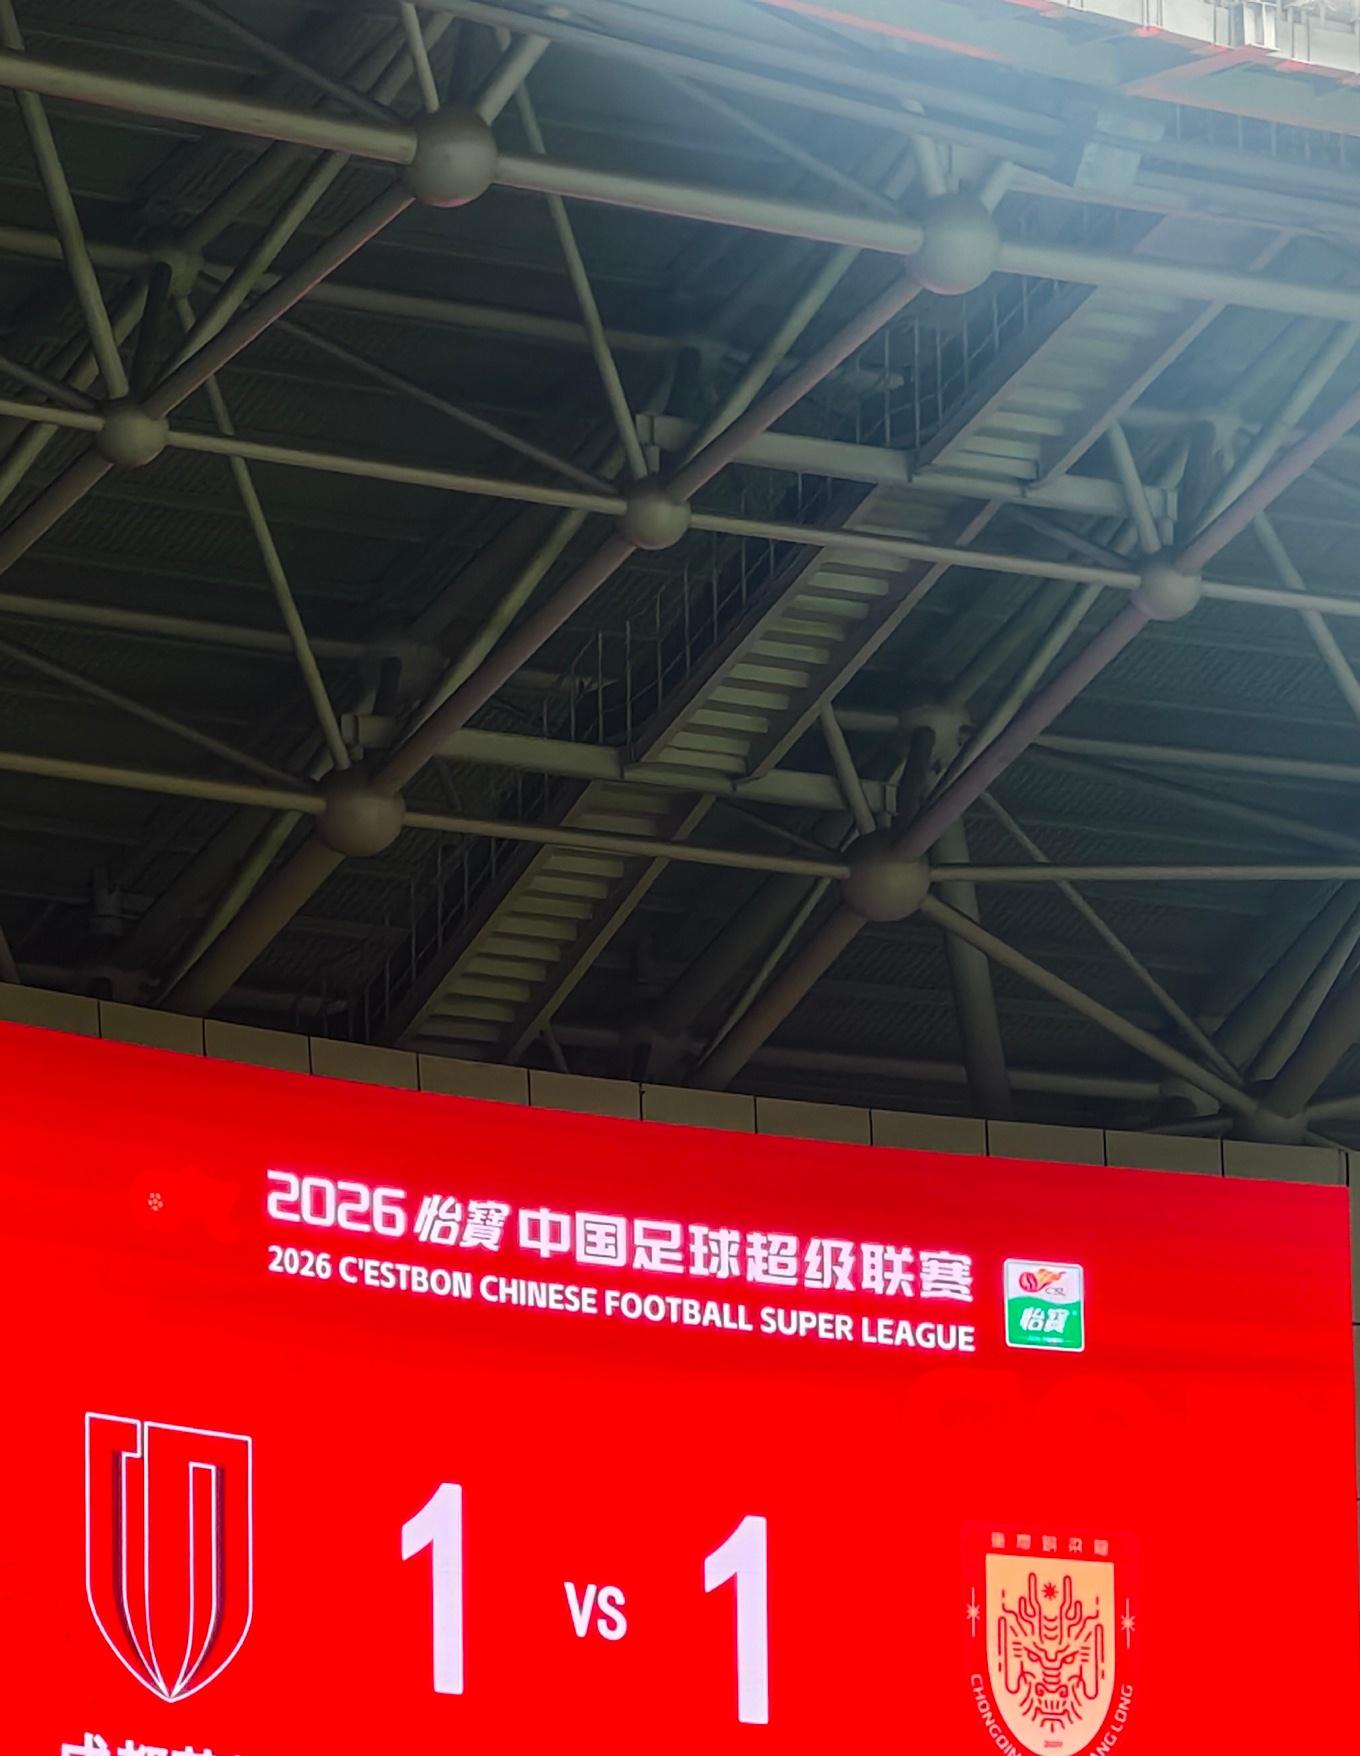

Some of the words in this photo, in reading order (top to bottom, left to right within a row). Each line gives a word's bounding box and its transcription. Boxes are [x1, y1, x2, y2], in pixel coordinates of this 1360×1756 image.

[267, 1169, 407, 1237] 2026
[519, 1207, 974, 1303] 中国足球超级联赛
[268, 1245, 332, 1280] 2026
[339, 1256, 472, 1299] C'ESTBON
[480, 1275, 598, 1314] CHINESE
[604, 1290, 753, 1332] FOOTBALL
[760, 1306, 854, 1341] SUPER
[861, 1316, 976, 1352] LEAGUE
[401, 1482, 464, 1695] 1
[563, 1581, 627, 1641] VS
[704, 1515, 769, 1725] 1
